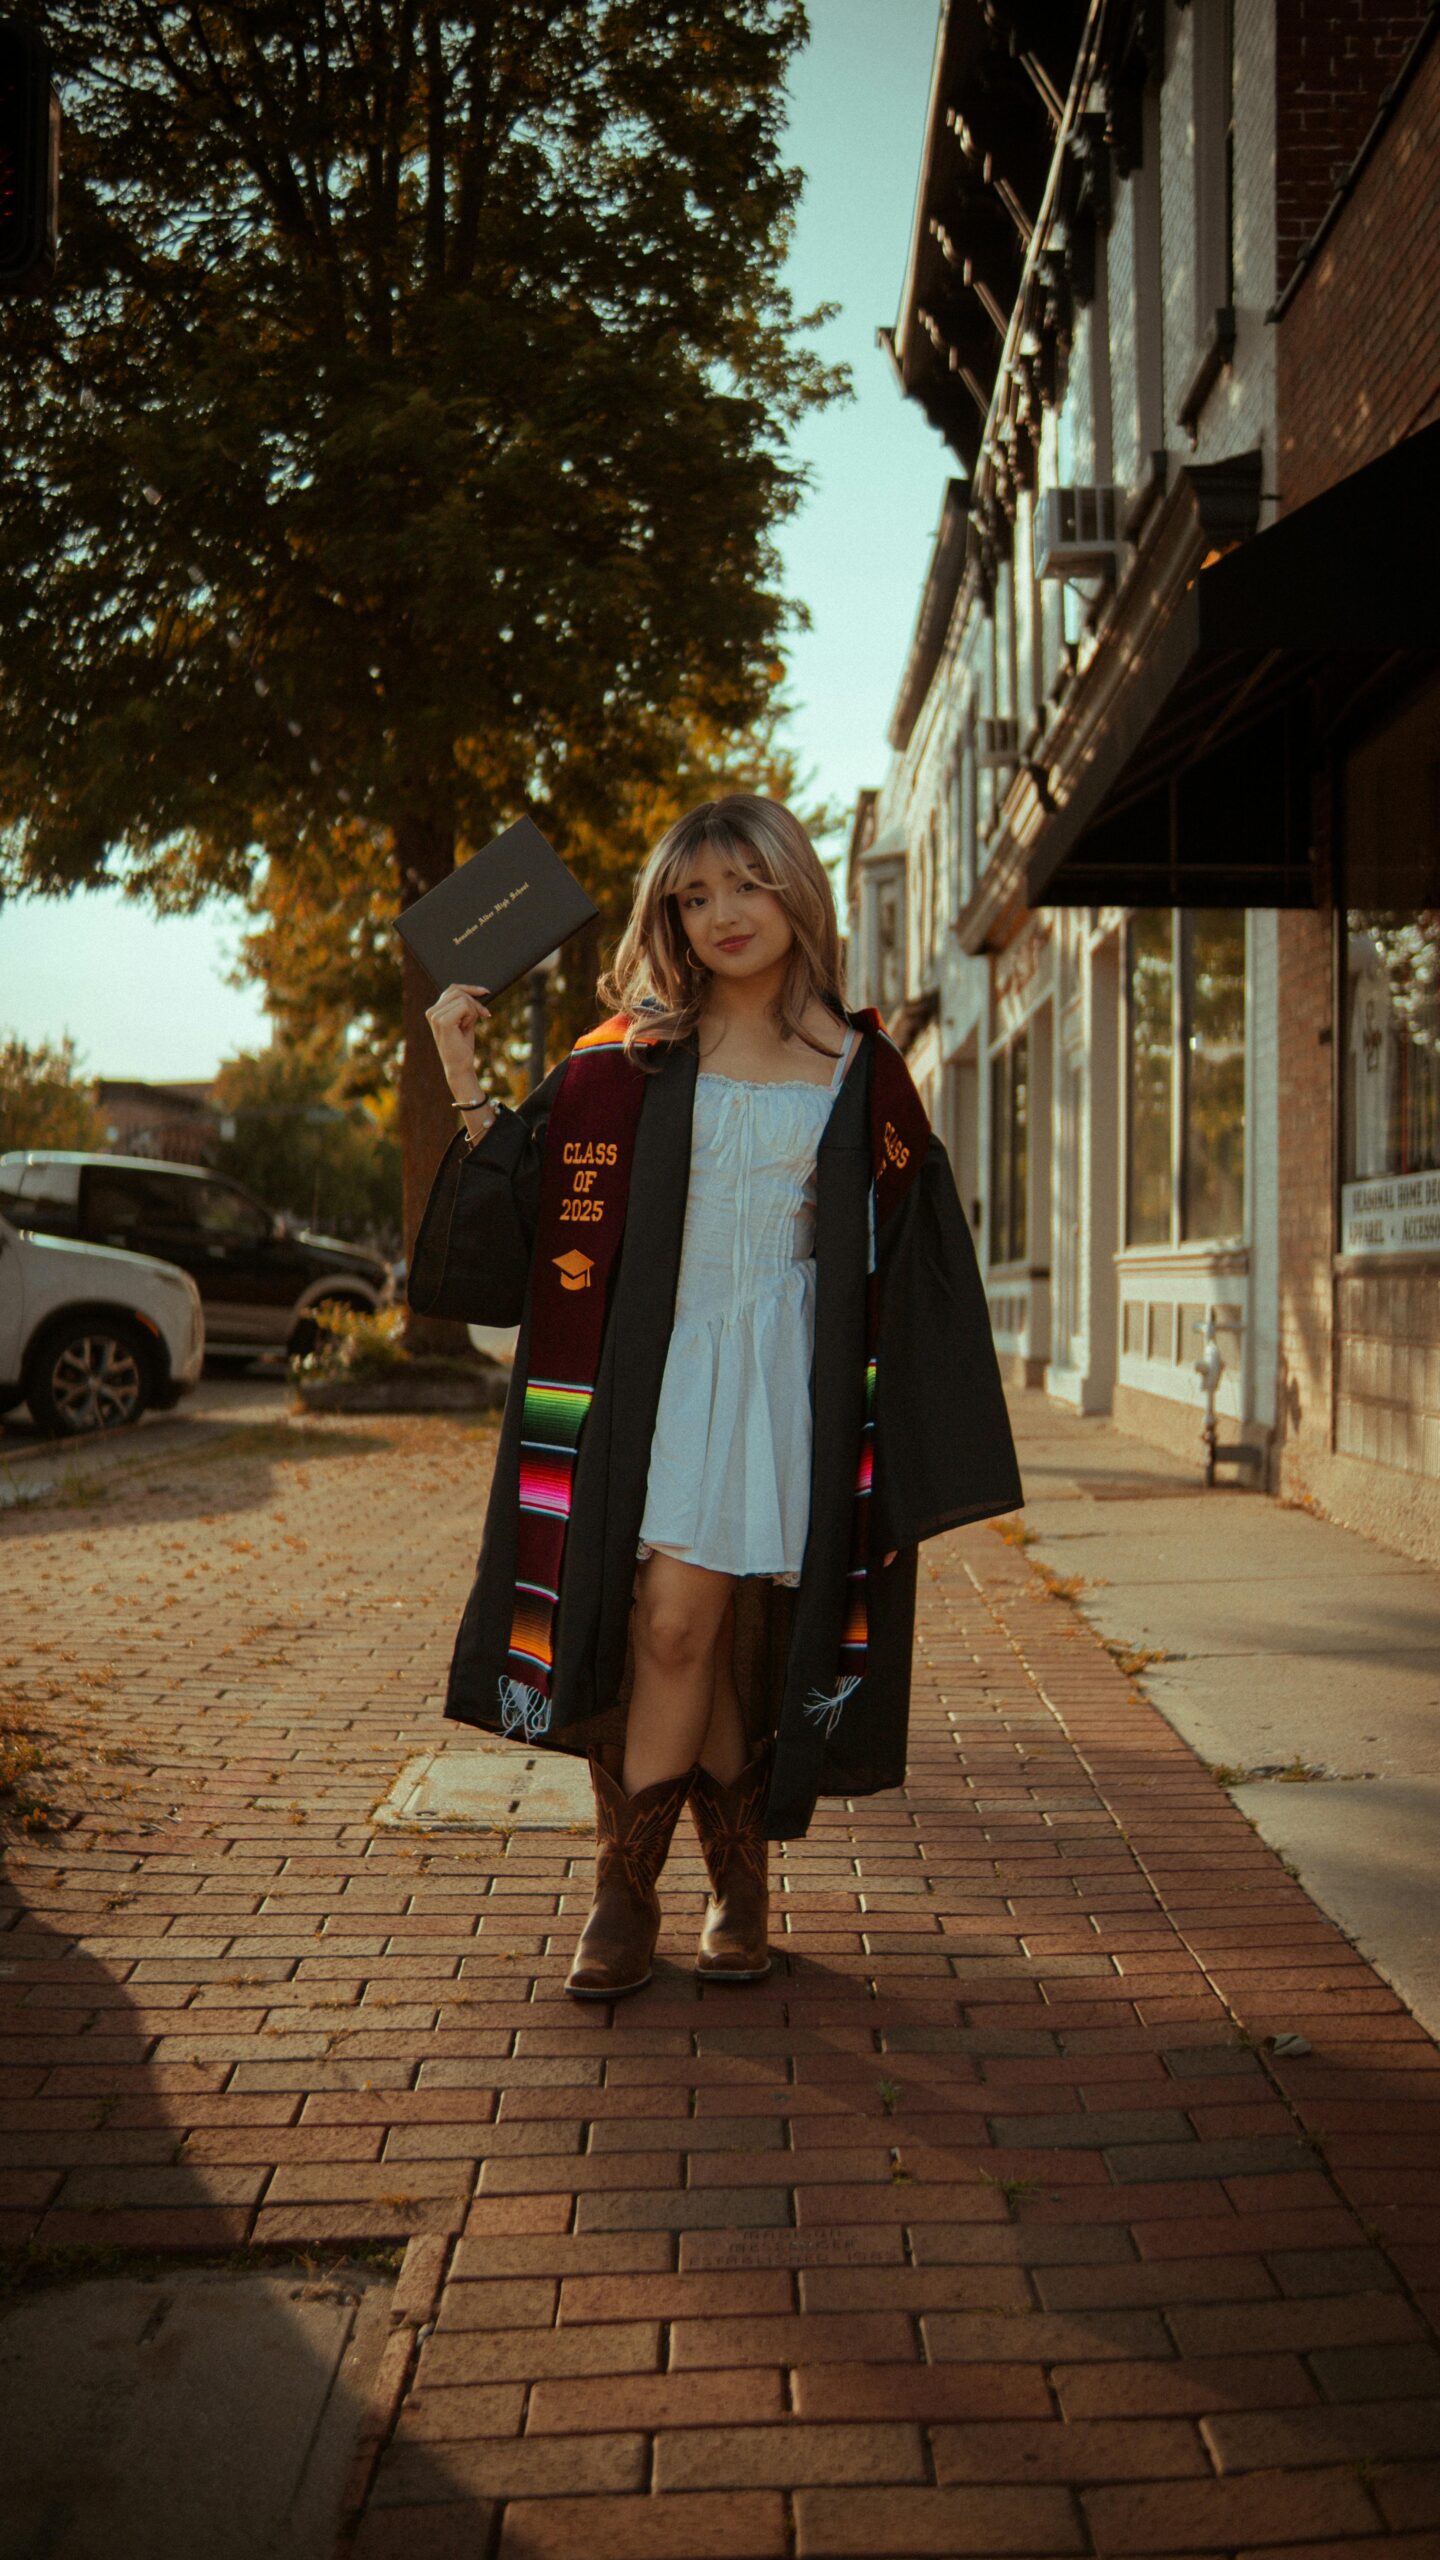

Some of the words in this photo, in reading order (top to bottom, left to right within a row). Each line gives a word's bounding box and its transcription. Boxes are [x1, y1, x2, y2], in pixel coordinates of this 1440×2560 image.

[563, 1141, 618, 1166] CLASS
[573, 1170, 598, 1193] OF
[1397, 1181, 1423, 1208] HOME
[559, 1198, 605, 1222] 2025
